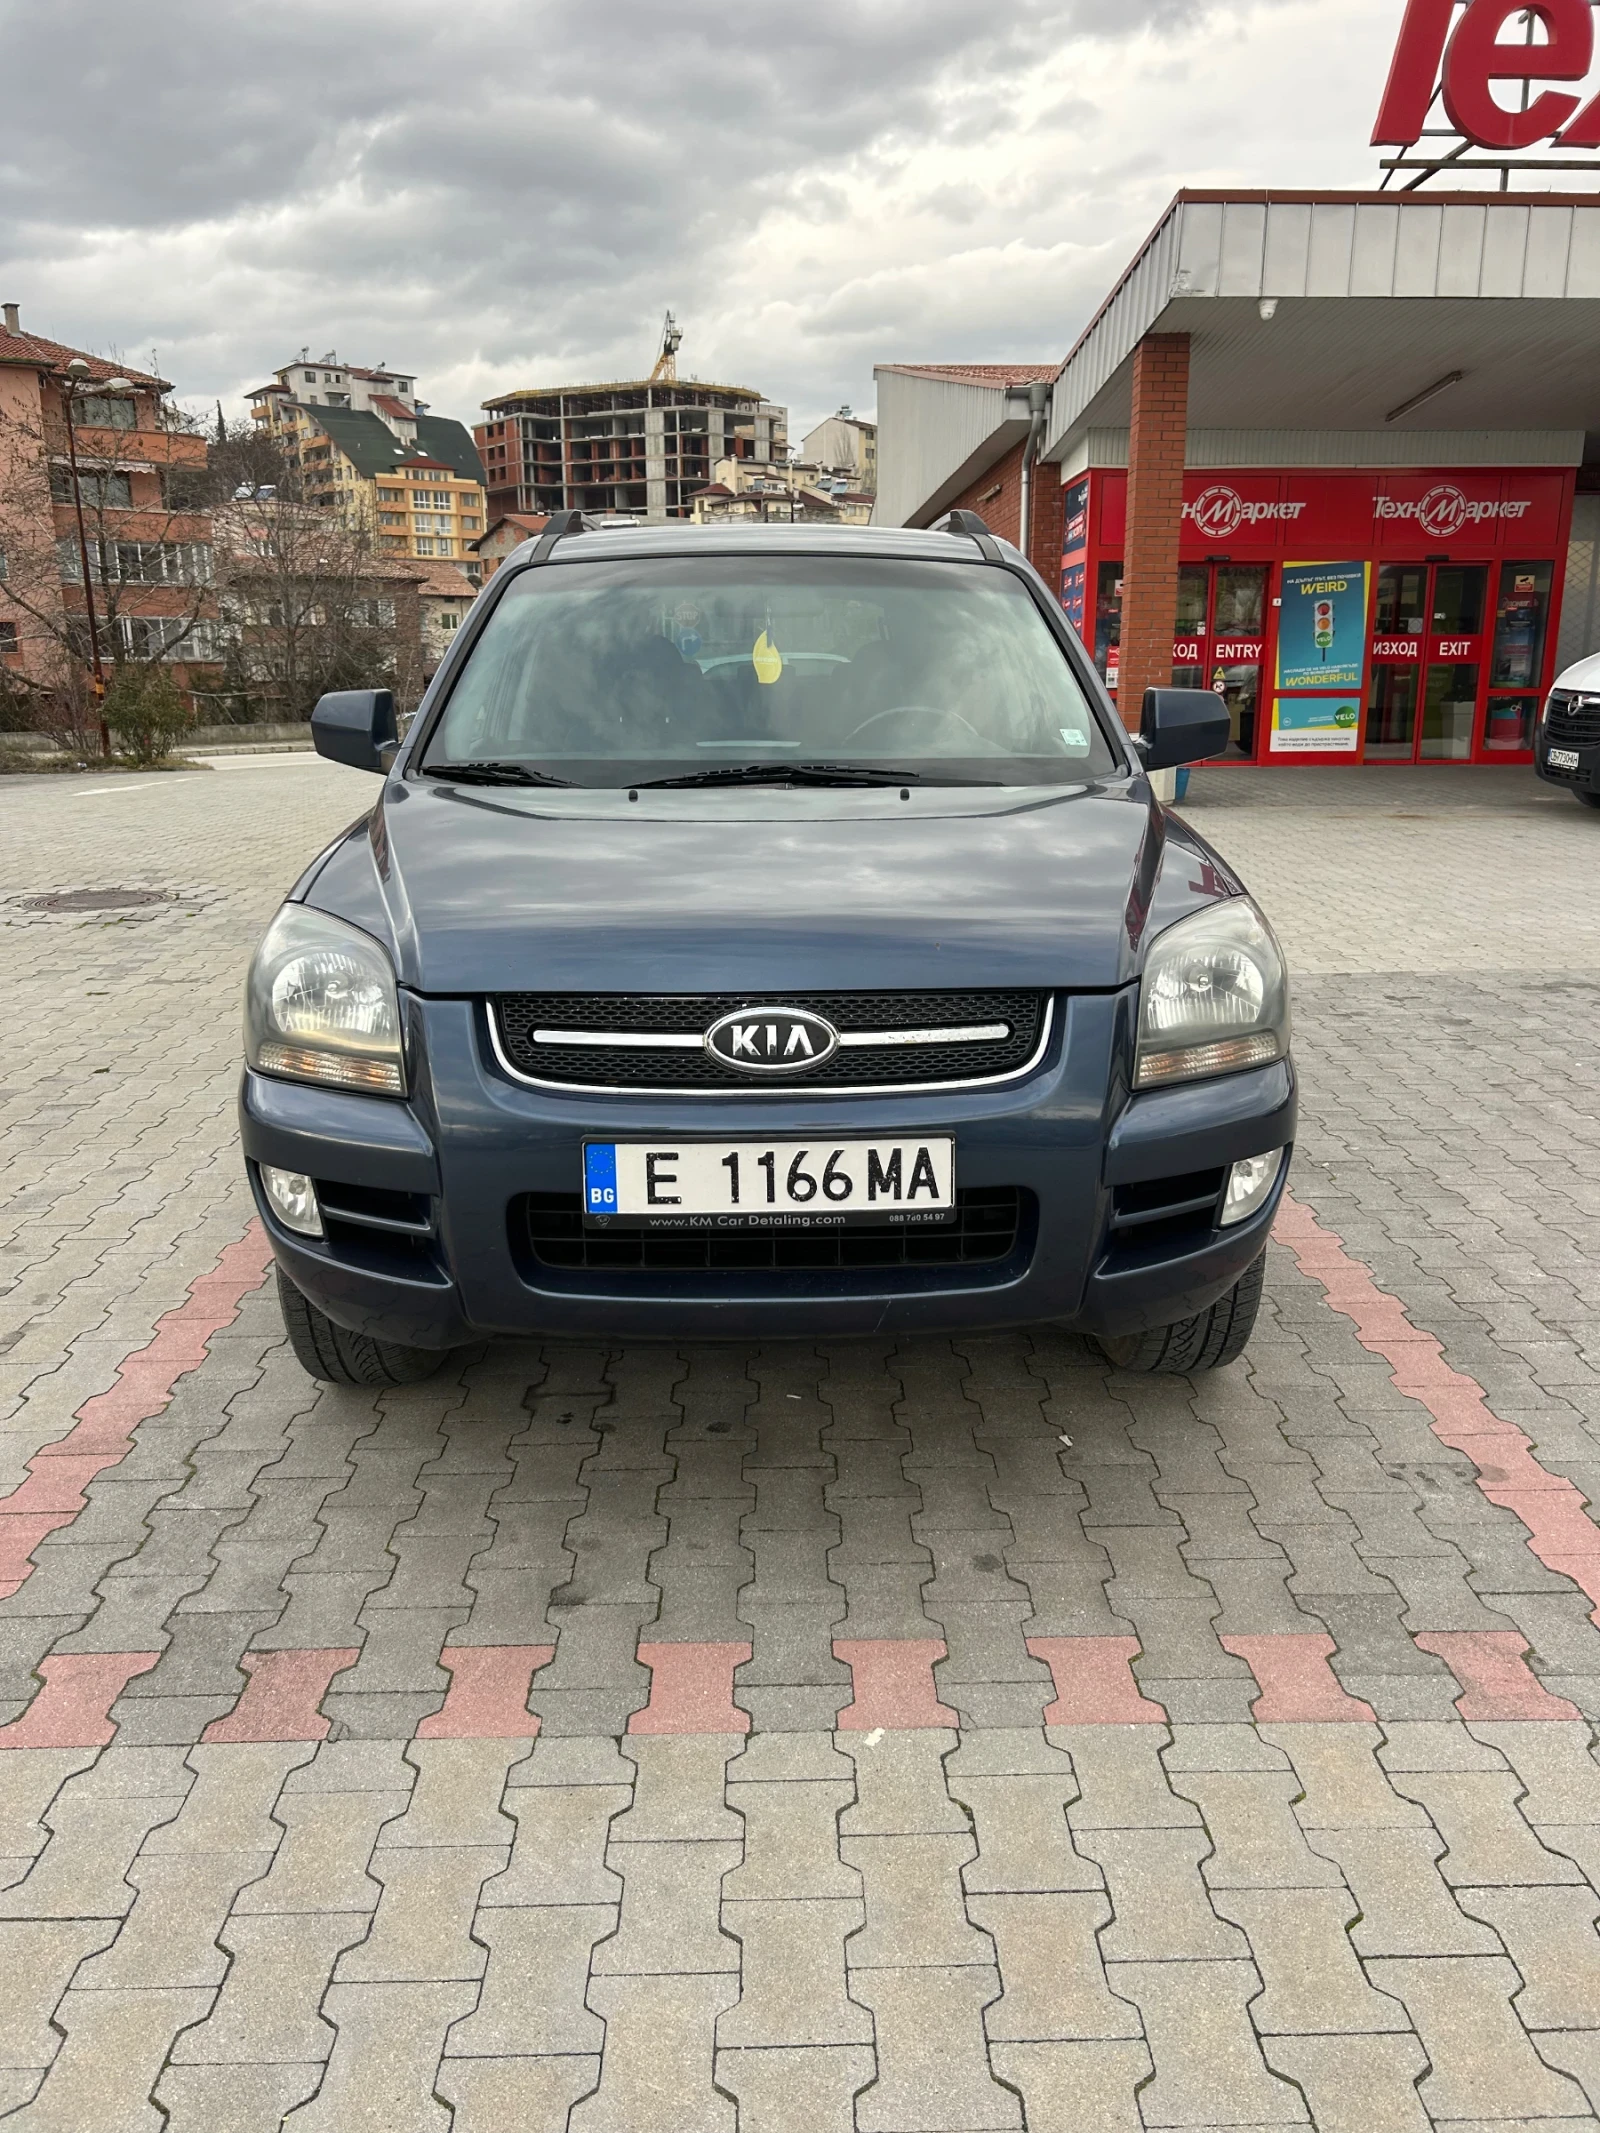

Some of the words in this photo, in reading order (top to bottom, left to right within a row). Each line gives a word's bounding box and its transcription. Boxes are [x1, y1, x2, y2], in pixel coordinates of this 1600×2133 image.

[1369, 0, 1600, 150] Те
[1301, 580, 1347, 595] WEIRD
[675, 611, 698, 620] STOP
[1215, 643, 1262, 658] ENTRY
[1373, 641, 1418, 657] ИЗХОД
[1439, 641, 1471, 656] EXIT
[1285, 672, 1358, 686] WONDERFUL
[730, 1024, 814, 1056] KIA
[646, 1152, 682, 1204] E
[722, 1150, 853, 1203] 1166
[591, 1187, 614, 1203] BG
[650, 1216, 712, 1226] www.KM
[717, 1216, 744, 1226] Car
[749, 1214, 846, 1227] Detaling.com
